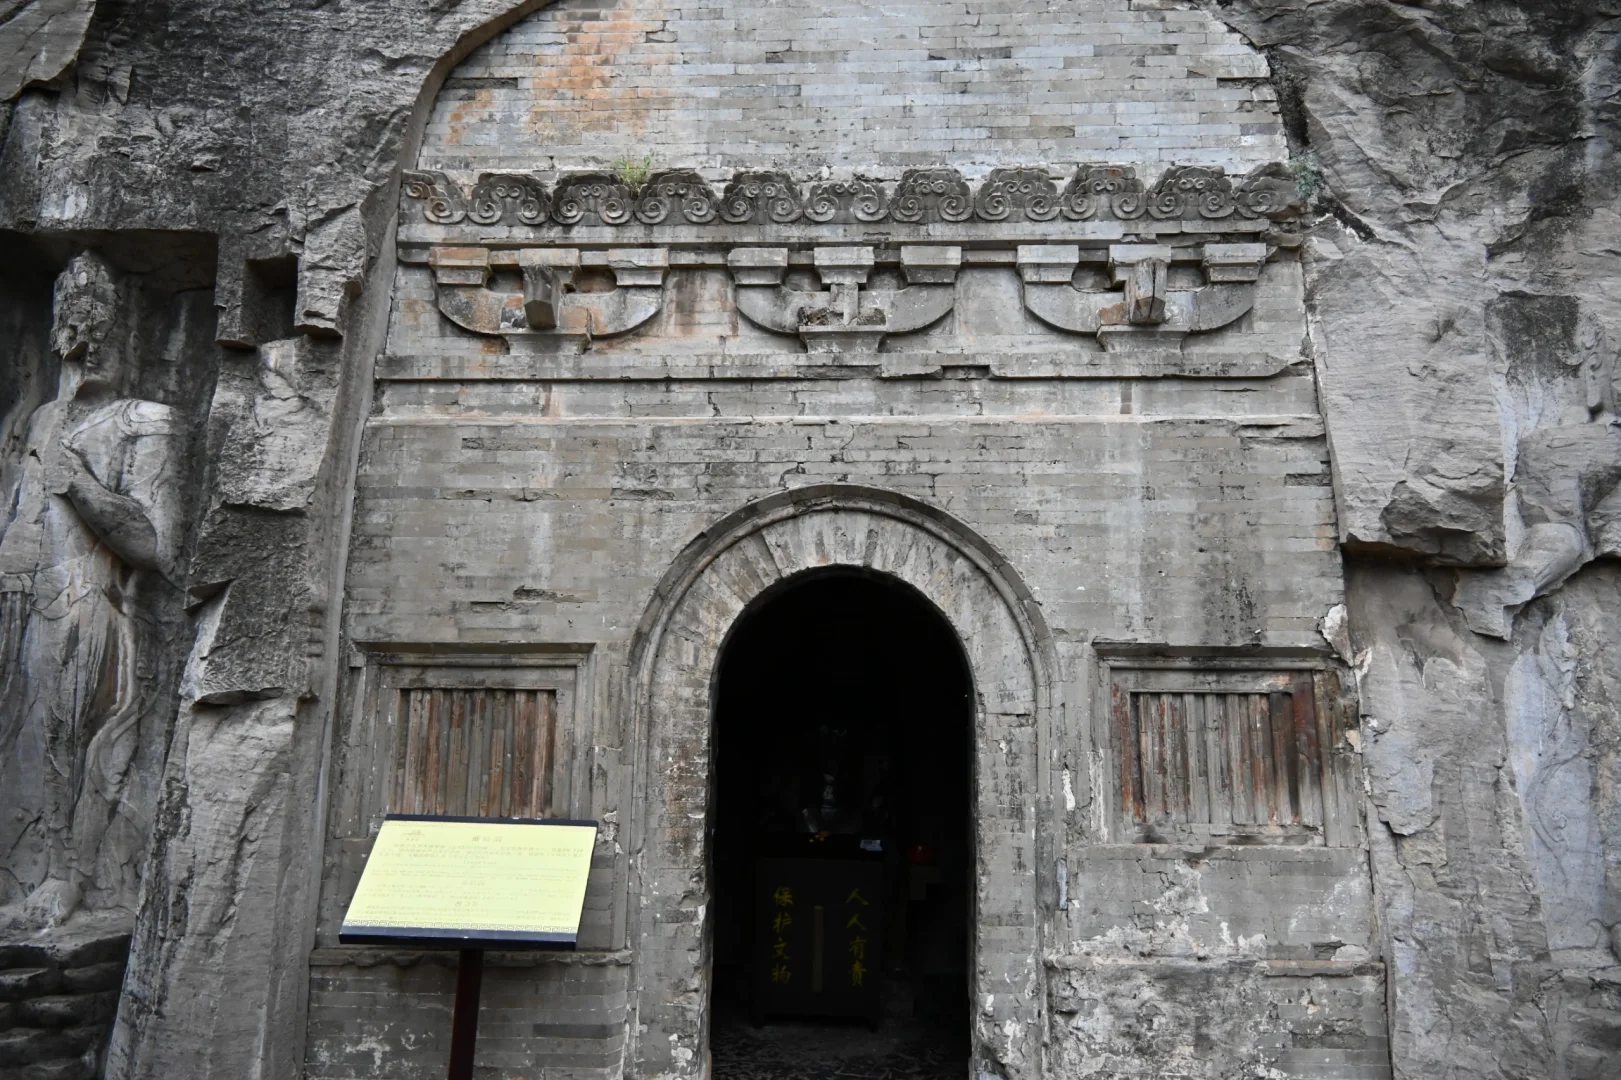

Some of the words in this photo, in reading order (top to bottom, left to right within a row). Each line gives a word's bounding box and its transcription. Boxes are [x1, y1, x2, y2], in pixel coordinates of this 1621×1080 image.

[772, 886, 794, 984] 保护文物
[845, 887, 871, 986] 人人有责
